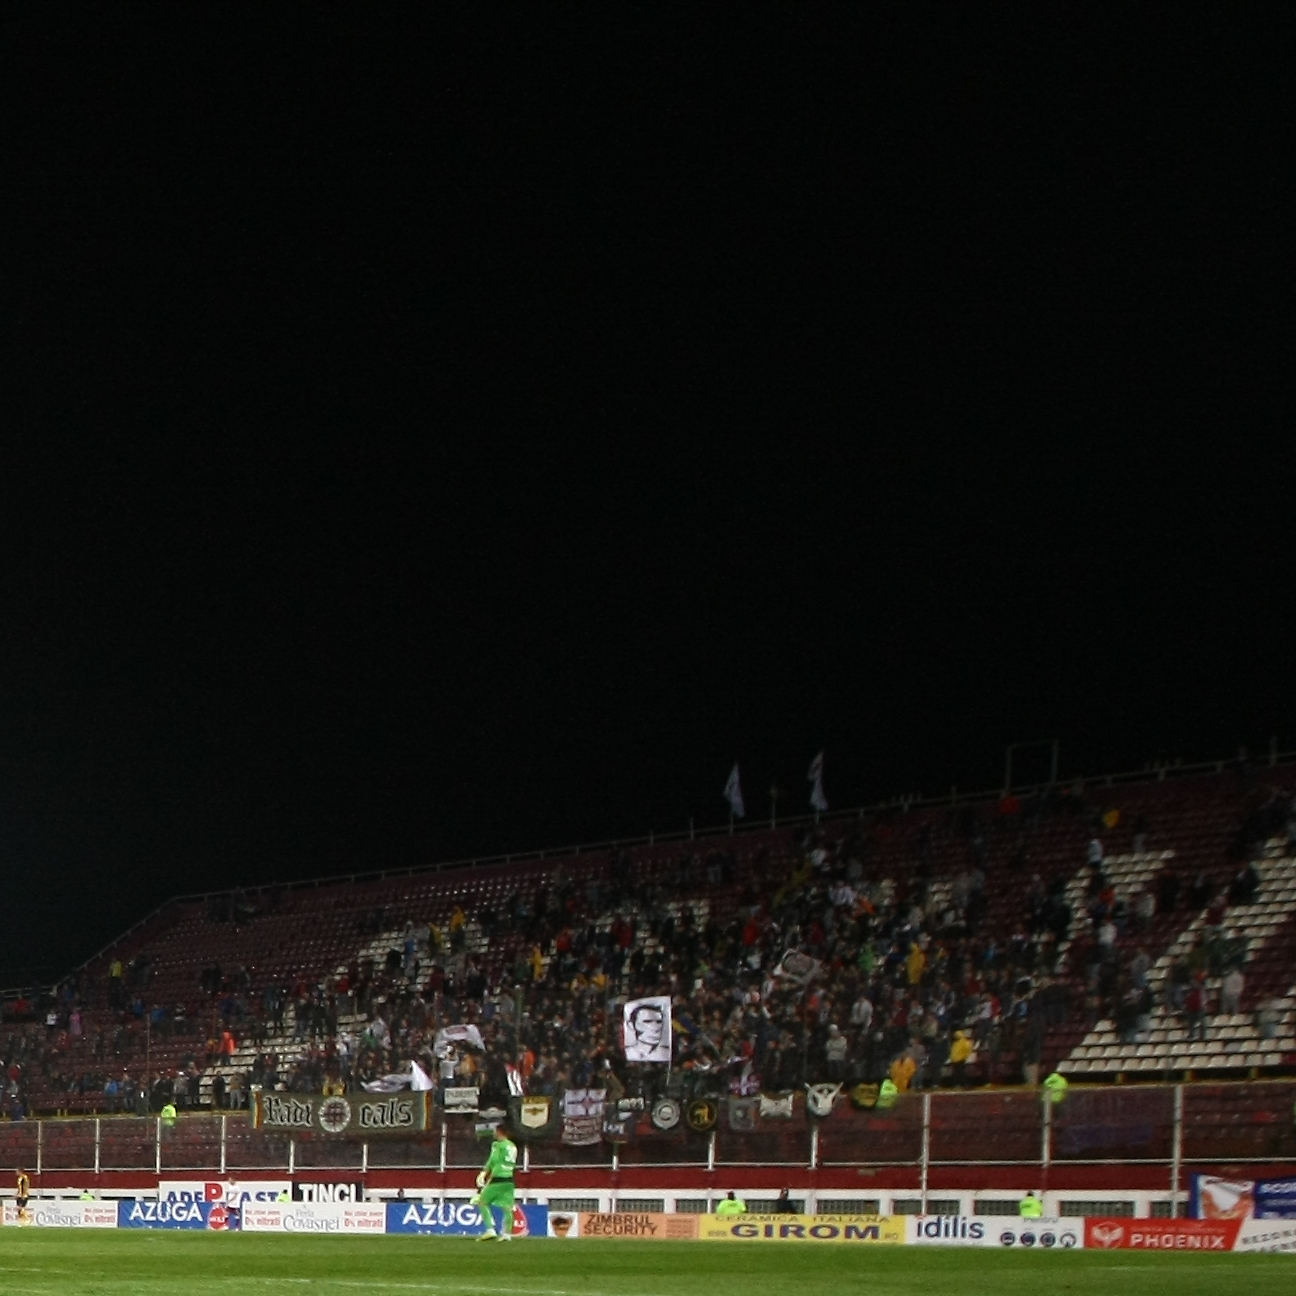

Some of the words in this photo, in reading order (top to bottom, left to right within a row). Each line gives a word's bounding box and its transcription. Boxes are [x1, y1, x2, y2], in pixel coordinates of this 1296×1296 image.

[129, 1201, 204, 1222] AZUGA
[588, 1214, 655, 1225] ZIMBRUL
[584, 1225, 657, 1235] SECURITY
[731, 1223, 880, 1240] GIROM
[916, 1216, 985, 1239] idilis
[1131, 1233, 1225, 1249] PHOENIX
